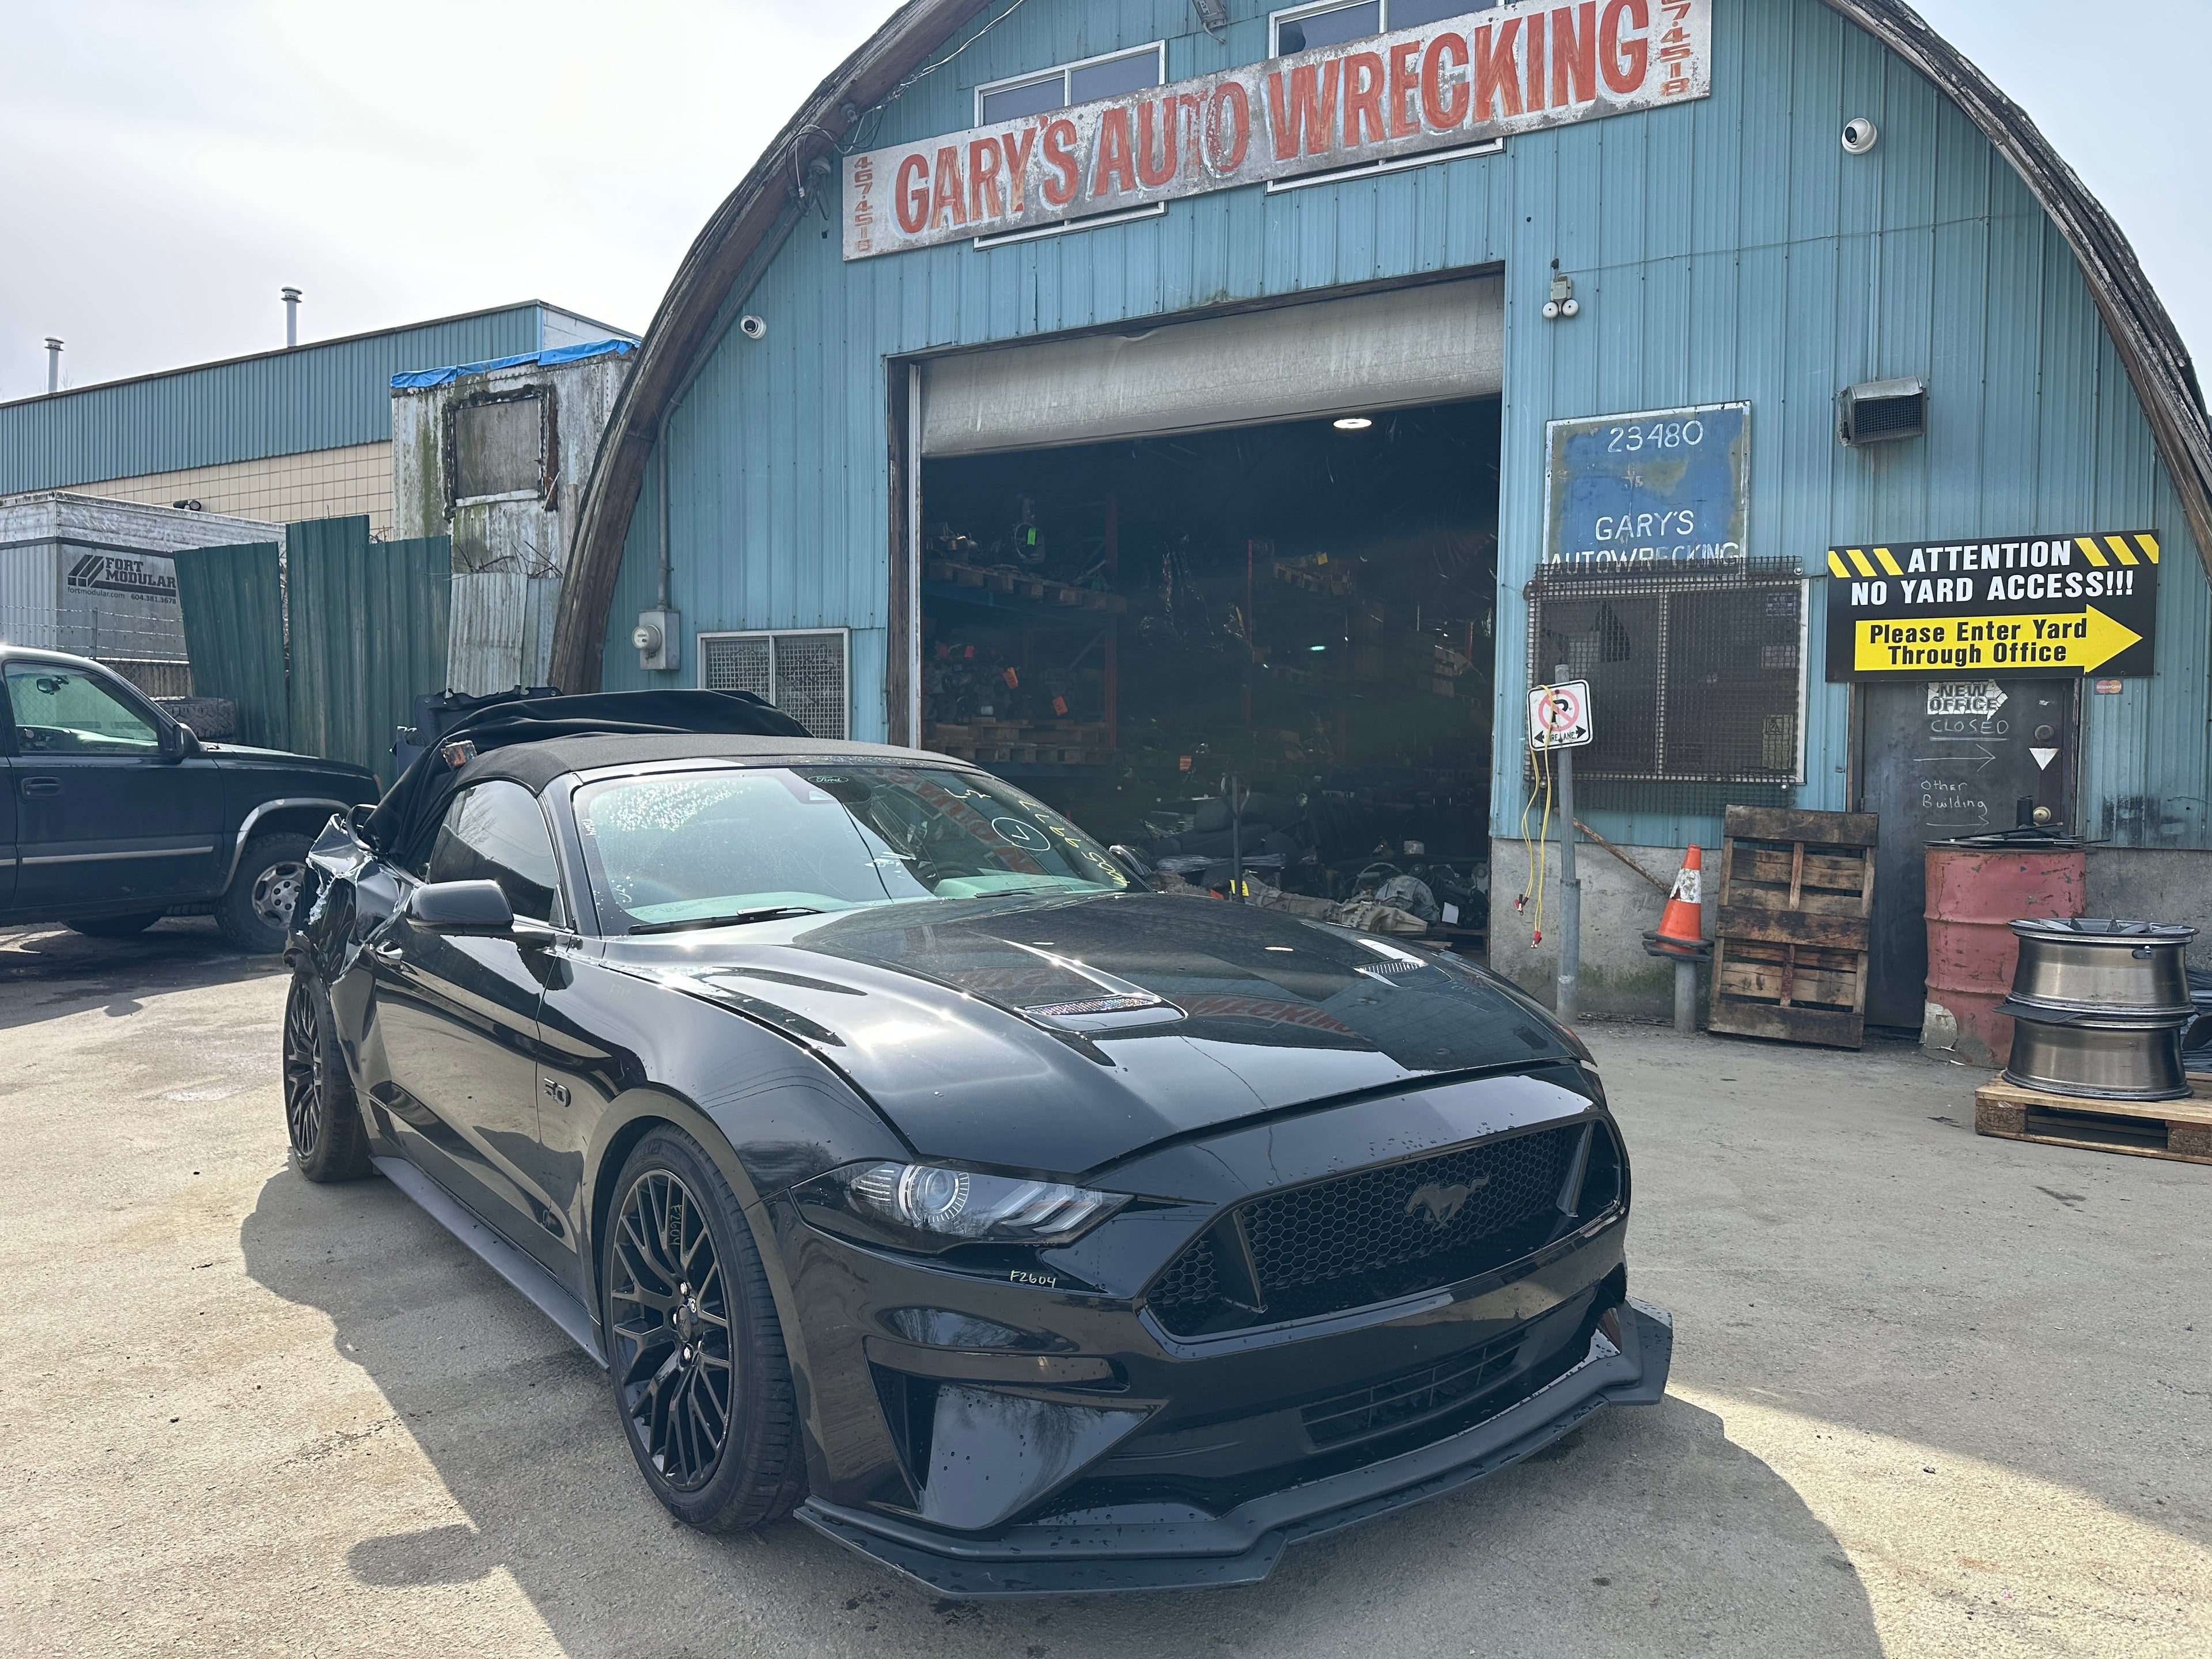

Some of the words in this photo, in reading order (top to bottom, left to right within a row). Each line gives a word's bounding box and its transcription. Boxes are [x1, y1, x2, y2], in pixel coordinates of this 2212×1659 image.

[895, 116, 1078, 233] GARY'S
[1095, 82, 1248, 196] AUTO
[1267, 0, 1649, 161] WRECKING
[1608, 421, 1703, 452] 23480
[1595, 510, 1694, 541] GARY'S
[105, 557, 143, 572] FORT
[1907, 540, 2071, 573] ATTENTION
[105, 569, 176, 589] MODULAR
[1851, 581, 1887, 605] NO
[1901, 577, 1973, 604] YARD
[1987, 570, 2133, 601] ACCESS!!!
[67, 586, 125, 599] fortmodular.com
[131, 594, 177, 605] 604.381.3678
[1870, 624, 1945, 643] Please
[1957, 620, 2021, 641] Enter
[2033, 618, 2087, 639] Yard
[1888, 643, 1982, 666] Through
[1993, 642, 2067, 662] Office
[1940, 684, 1987, 697] NEW
[1930, 698, 1999, 711] OFFICE
[1930, 719, 2009, 734] CLOSED
[1923, 794, 1987, 817] Building
[1010, 1270, 1056, 1289] F2604
